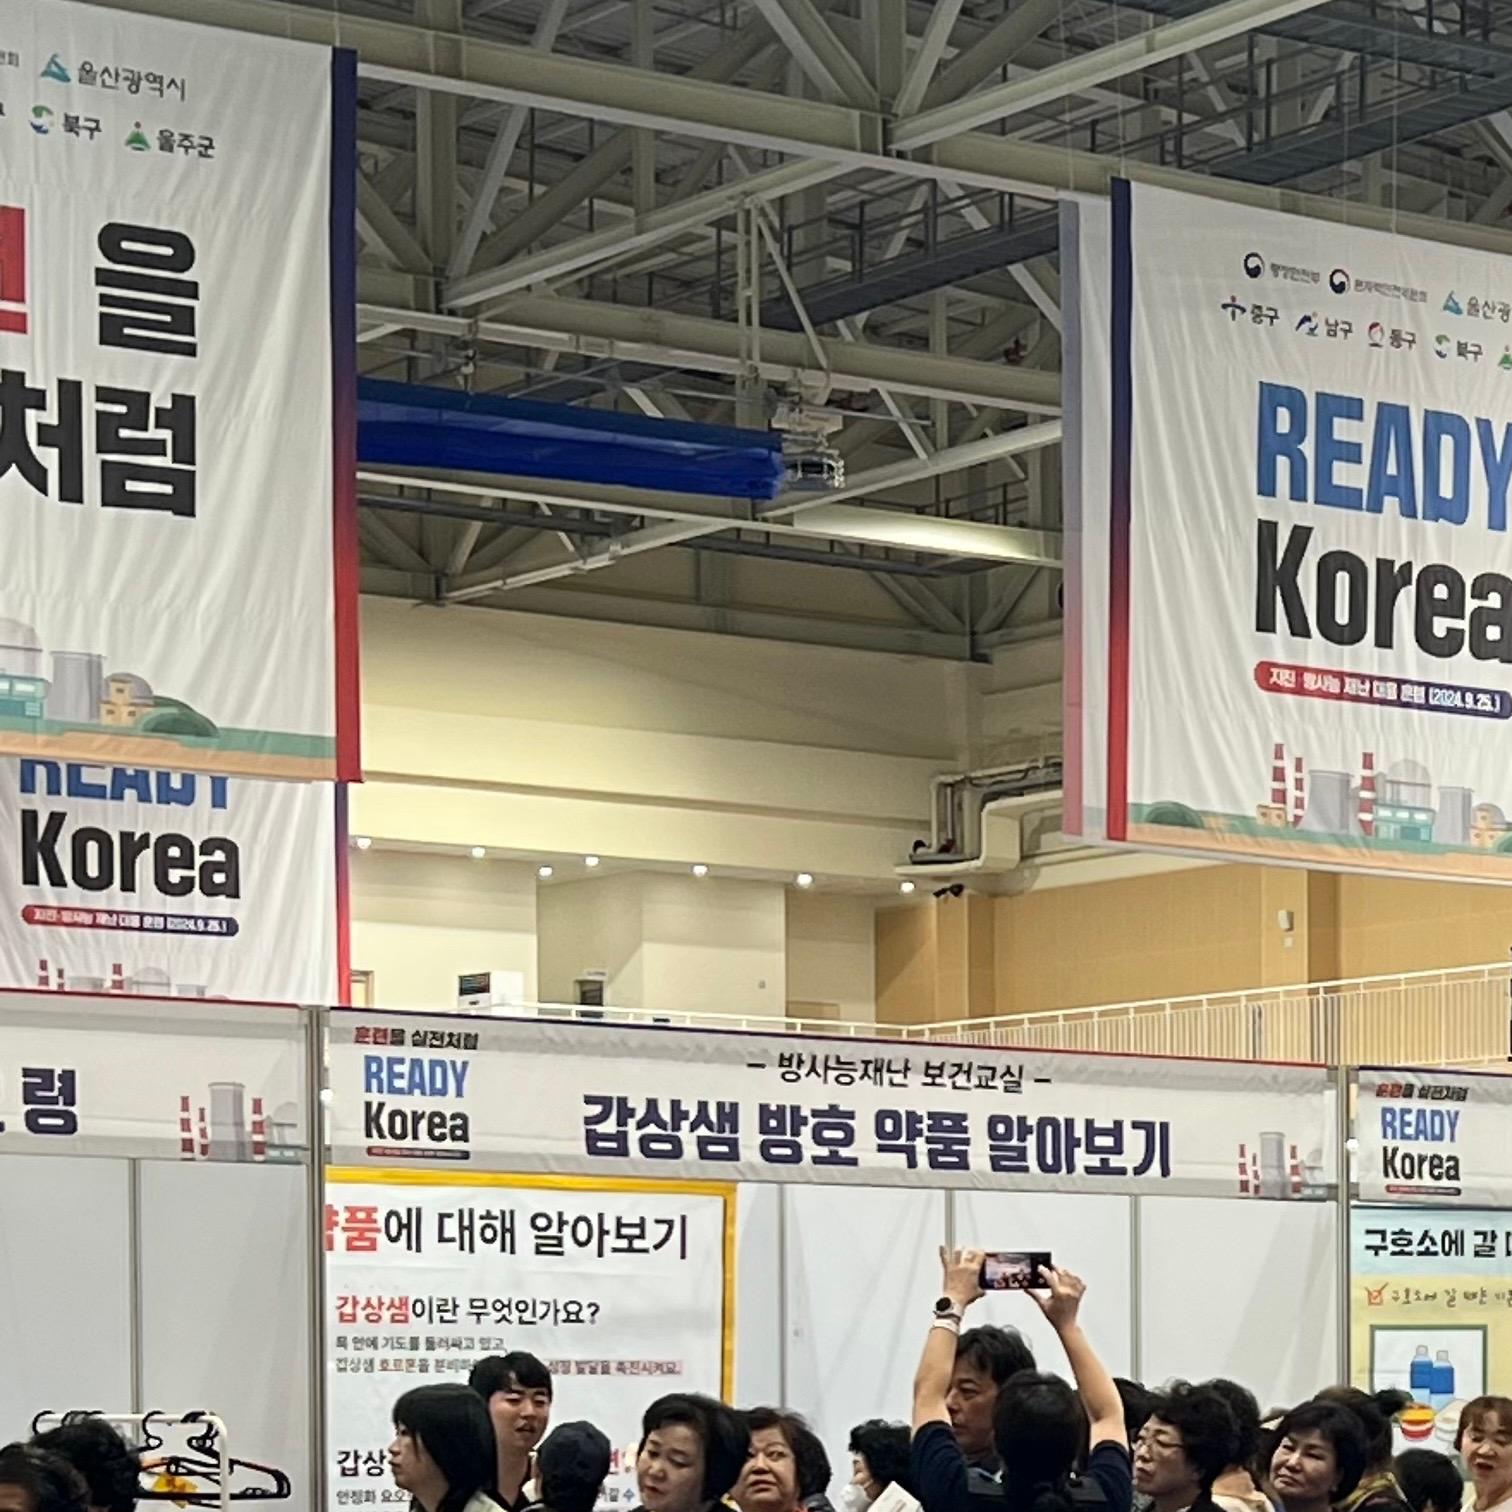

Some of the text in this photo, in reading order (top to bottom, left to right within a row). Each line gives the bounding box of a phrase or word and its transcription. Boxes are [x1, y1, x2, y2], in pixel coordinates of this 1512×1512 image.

[77, 60, 186, 102] 울산광역시
[62, 112, 216, 159] 북구 울주군
[1250, 303, 1280, 326] 중구
[1325, 317, 1353, 338] 남구
[1389, 329, 1417, 350] 동구
[1456, 340, 1484, 362] 북구
[20, 808, 240, 899] Korea
[364, 1054, 469, 1098] READY
[778, 1052, 912, 1088] 방사능재난
[924, 1063, 1024, 1094] 보건교실
[0, 1066, 78, 1136] 령
[364, 1102, 470, 1143] Korea
[583, 1093, 1172, 1178] 갑상샘 방호 약품 알아보기
[1380, 1106, 1460, 1143] READY
[1382, 1146, 1461, 1181] Korea
[437, 1207, 516, 1255] 대해
[529, 1211, 688, 1260] 알아보기
[1364, 1229, 1465, 1258] 구호소에
[1473, 1230, 1497, 1258] 갈
[336, 1295, 601, 1326] 갑상샘이란 무엇인가요?
[337, 1449, 387, 1477] 갑상
